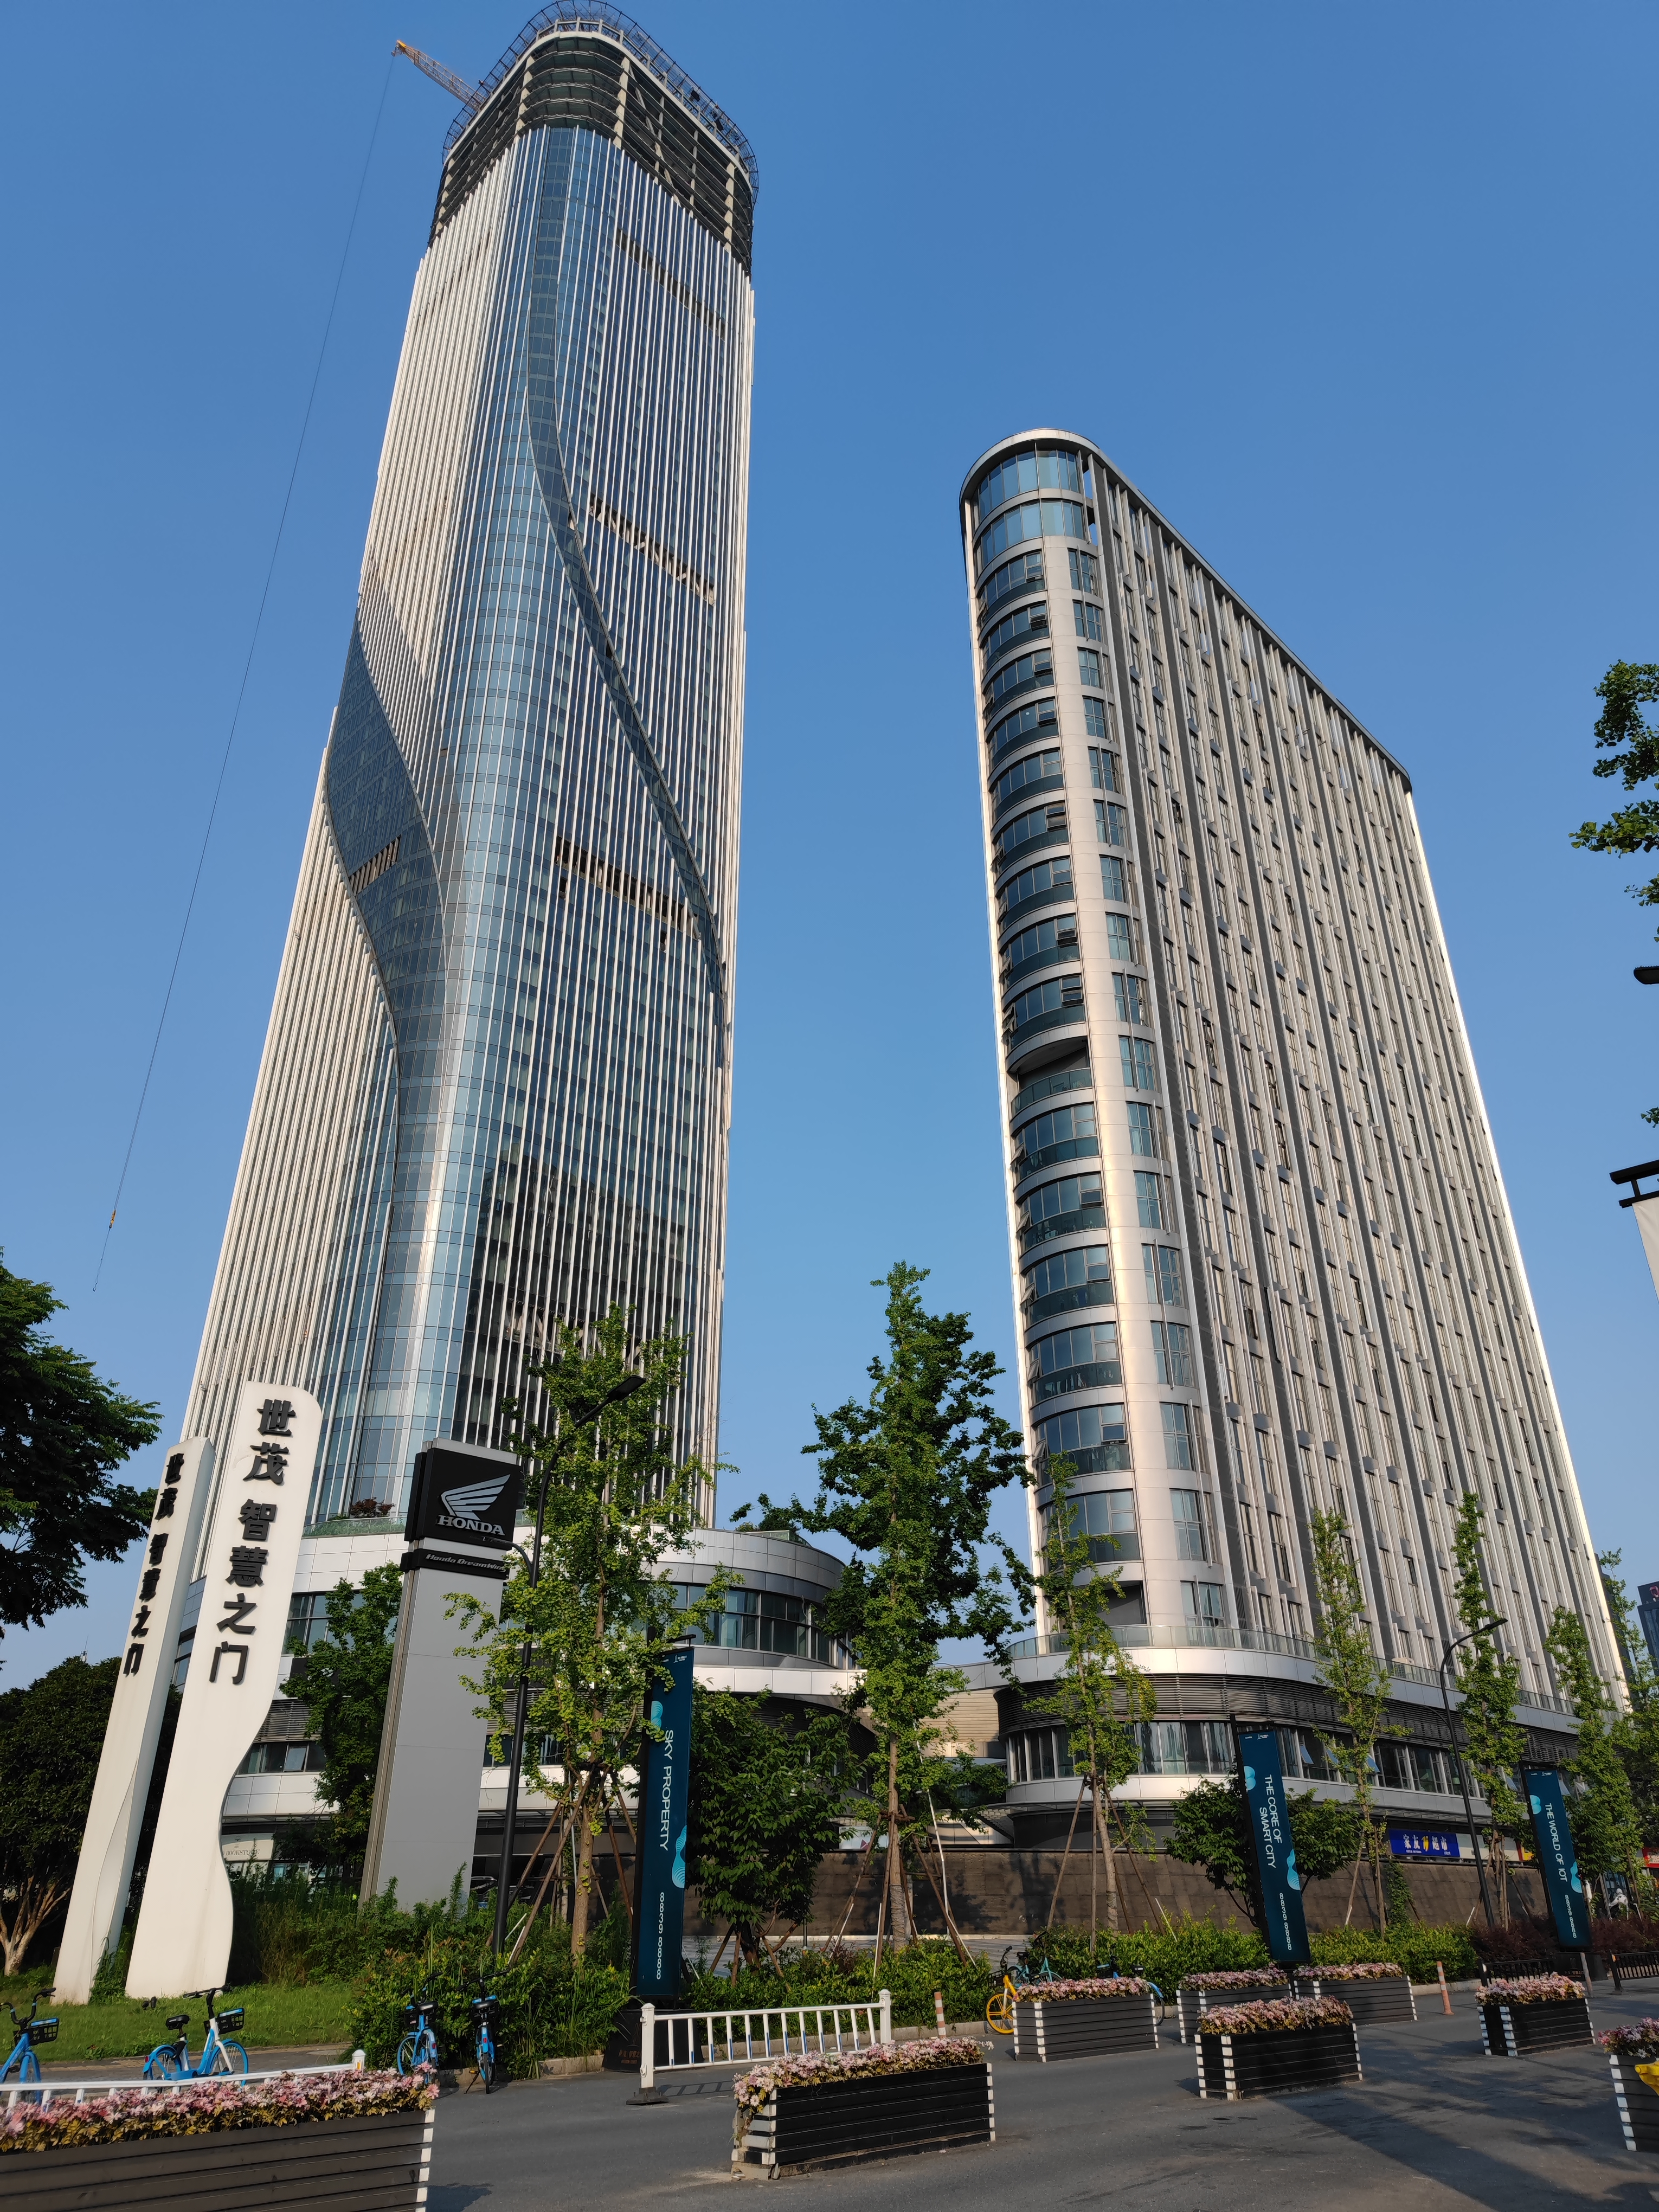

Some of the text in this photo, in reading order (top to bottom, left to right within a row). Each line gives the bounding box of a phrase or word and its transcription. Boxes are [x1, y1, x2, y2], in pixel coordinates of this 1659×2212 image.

[437, 1514, 505, 1536] HONDA
[426, 1554, 456, 1563] Honda
[659, 1729, 674, 1851] SKY PROPERTY
[1264, 1774, 1283, 1844] THE CORE OF
[1259, 1807, 1276, 1869] SMART CITY
[1545, 1803, 1568, 1882] THE WORLD OF IOT
[1284, 1922, 1292, 1951] 8888
